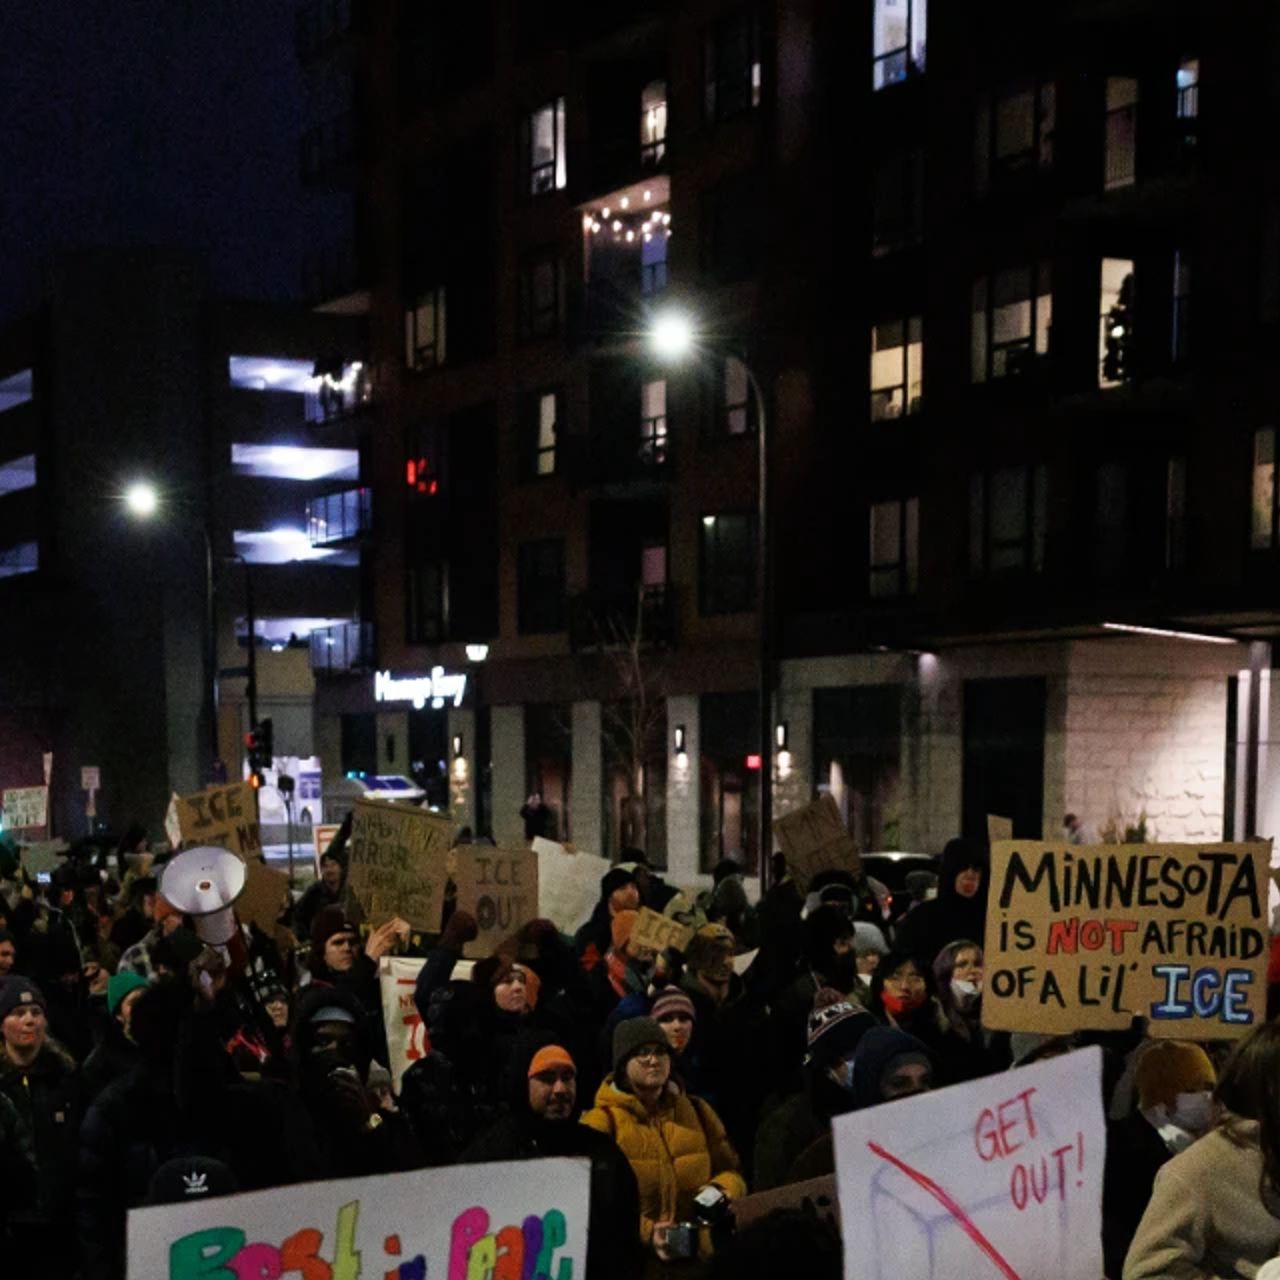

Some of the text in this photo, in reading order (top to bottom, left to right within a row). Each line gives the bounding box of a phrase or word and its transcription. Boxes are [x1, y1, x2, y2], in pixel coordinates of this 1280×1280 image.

[476, 857, 523, 885] ICE
[999, 851, 1261, 920] MiNNESOTA
[1046, 916, 1138, 955] NOT
[1141, 920, 1264, 960] AFRAiD
[991, 966, 1036, 998] OF
[1039, 970, 1066, 1008] A
[1150, 964, 1254, 1024] ICE
[975, 1087, 1037, 1162] GET
[1011, 1131, 1084, 1211] OUT!
